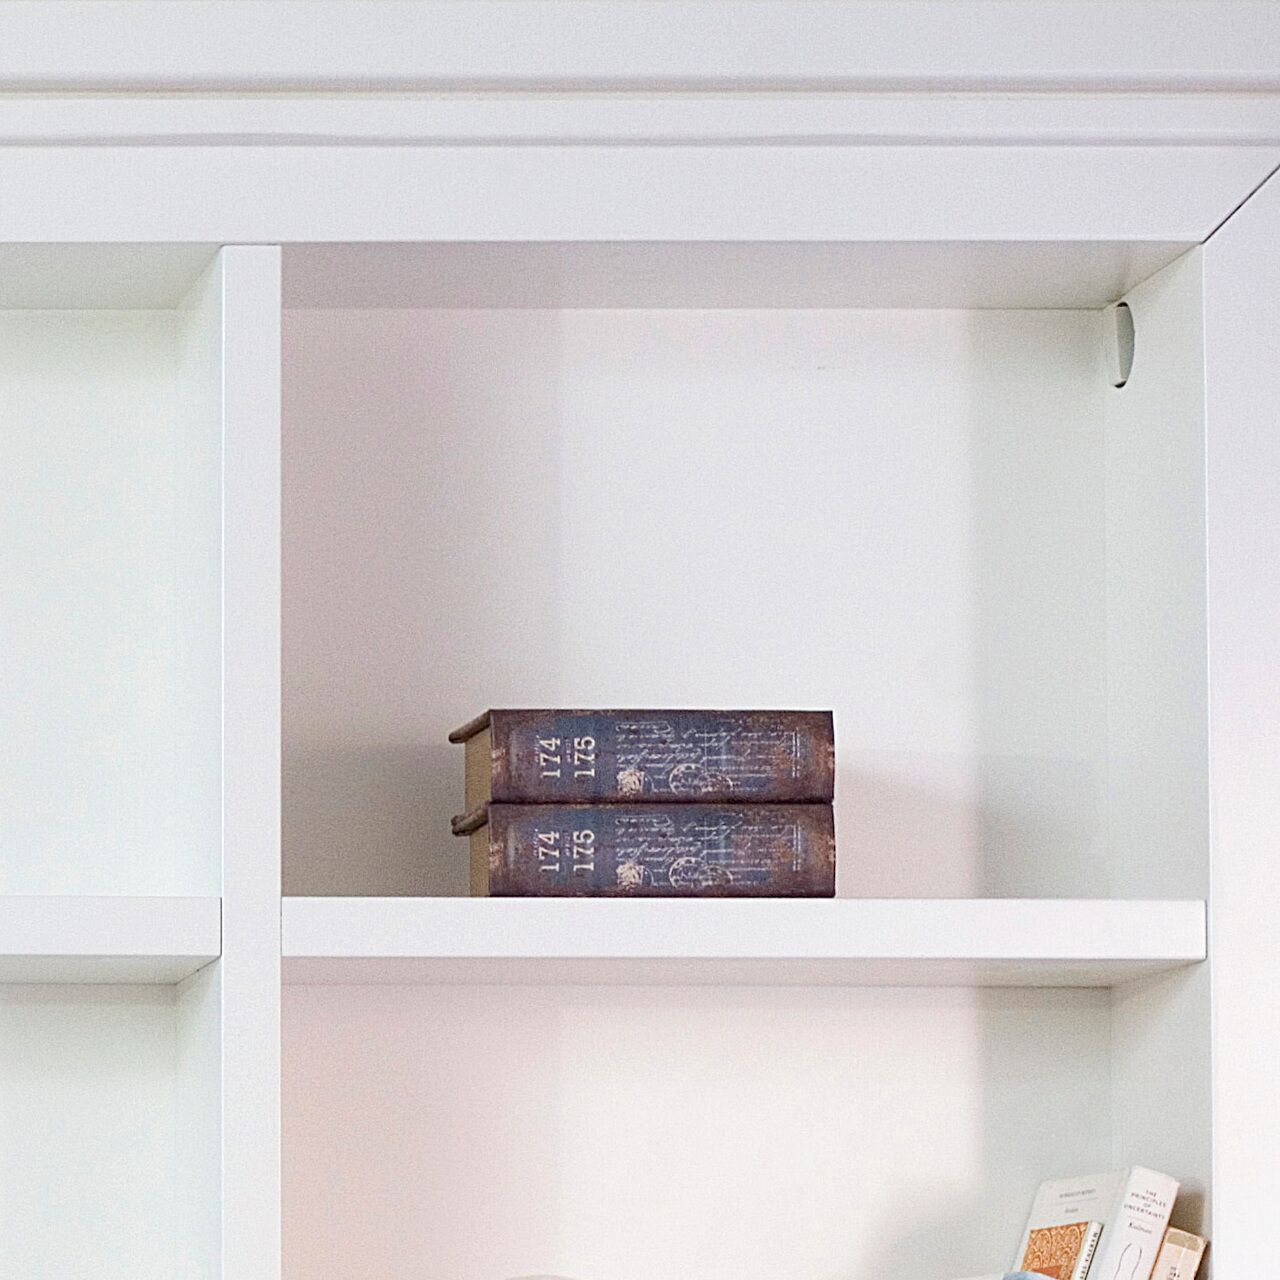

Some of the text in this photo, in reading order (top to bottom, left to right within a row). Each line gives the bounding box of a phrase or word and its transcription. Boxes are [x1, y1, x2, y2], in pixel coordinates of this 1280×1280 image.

[540, 736, 562, 779] 174
[574, 736, 595, 779] 175
[539, 830, 561, 873] 174
[573, 829, 595, 872] 175
